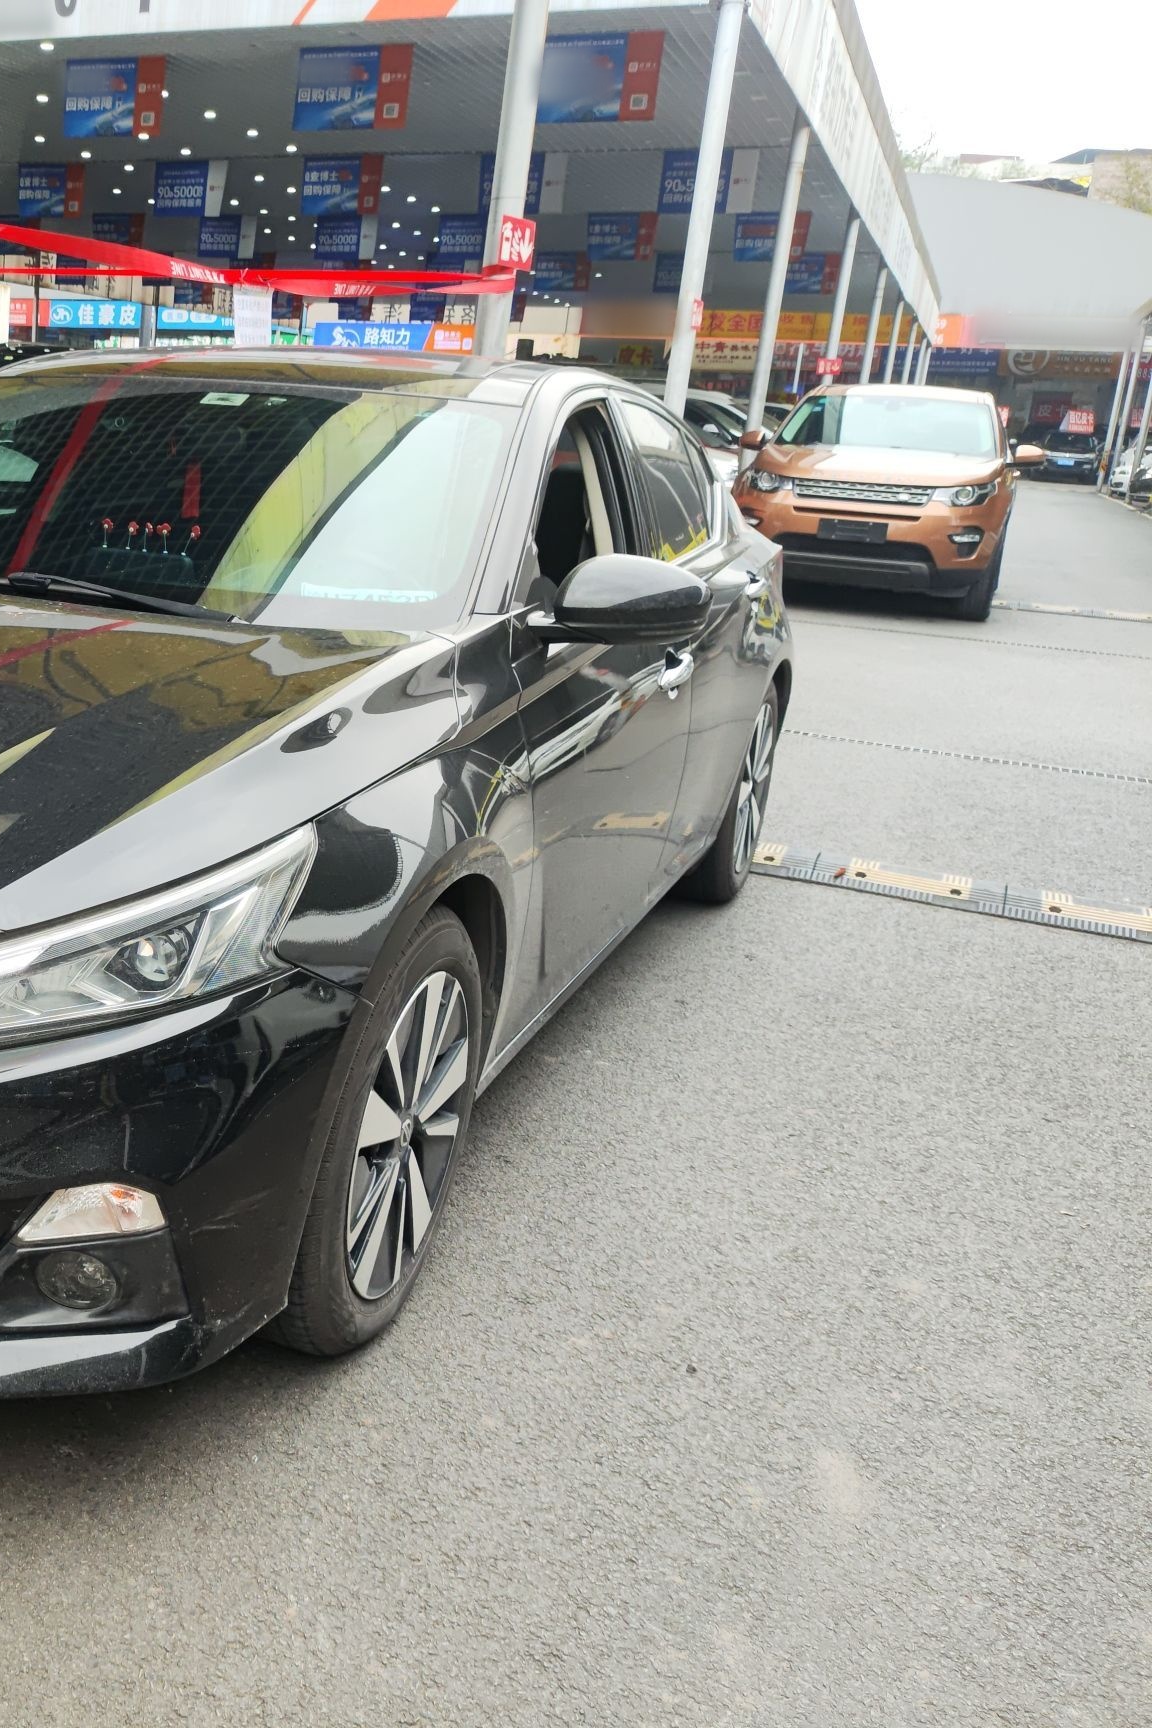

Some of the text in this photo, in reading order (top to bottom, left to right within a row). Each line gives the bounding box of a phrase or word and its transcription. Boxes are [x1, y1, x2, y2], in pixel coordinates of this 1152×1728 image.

[77, 303, 136, 326] 佳豪皮
[363, 326, 411, 346] 路知力
